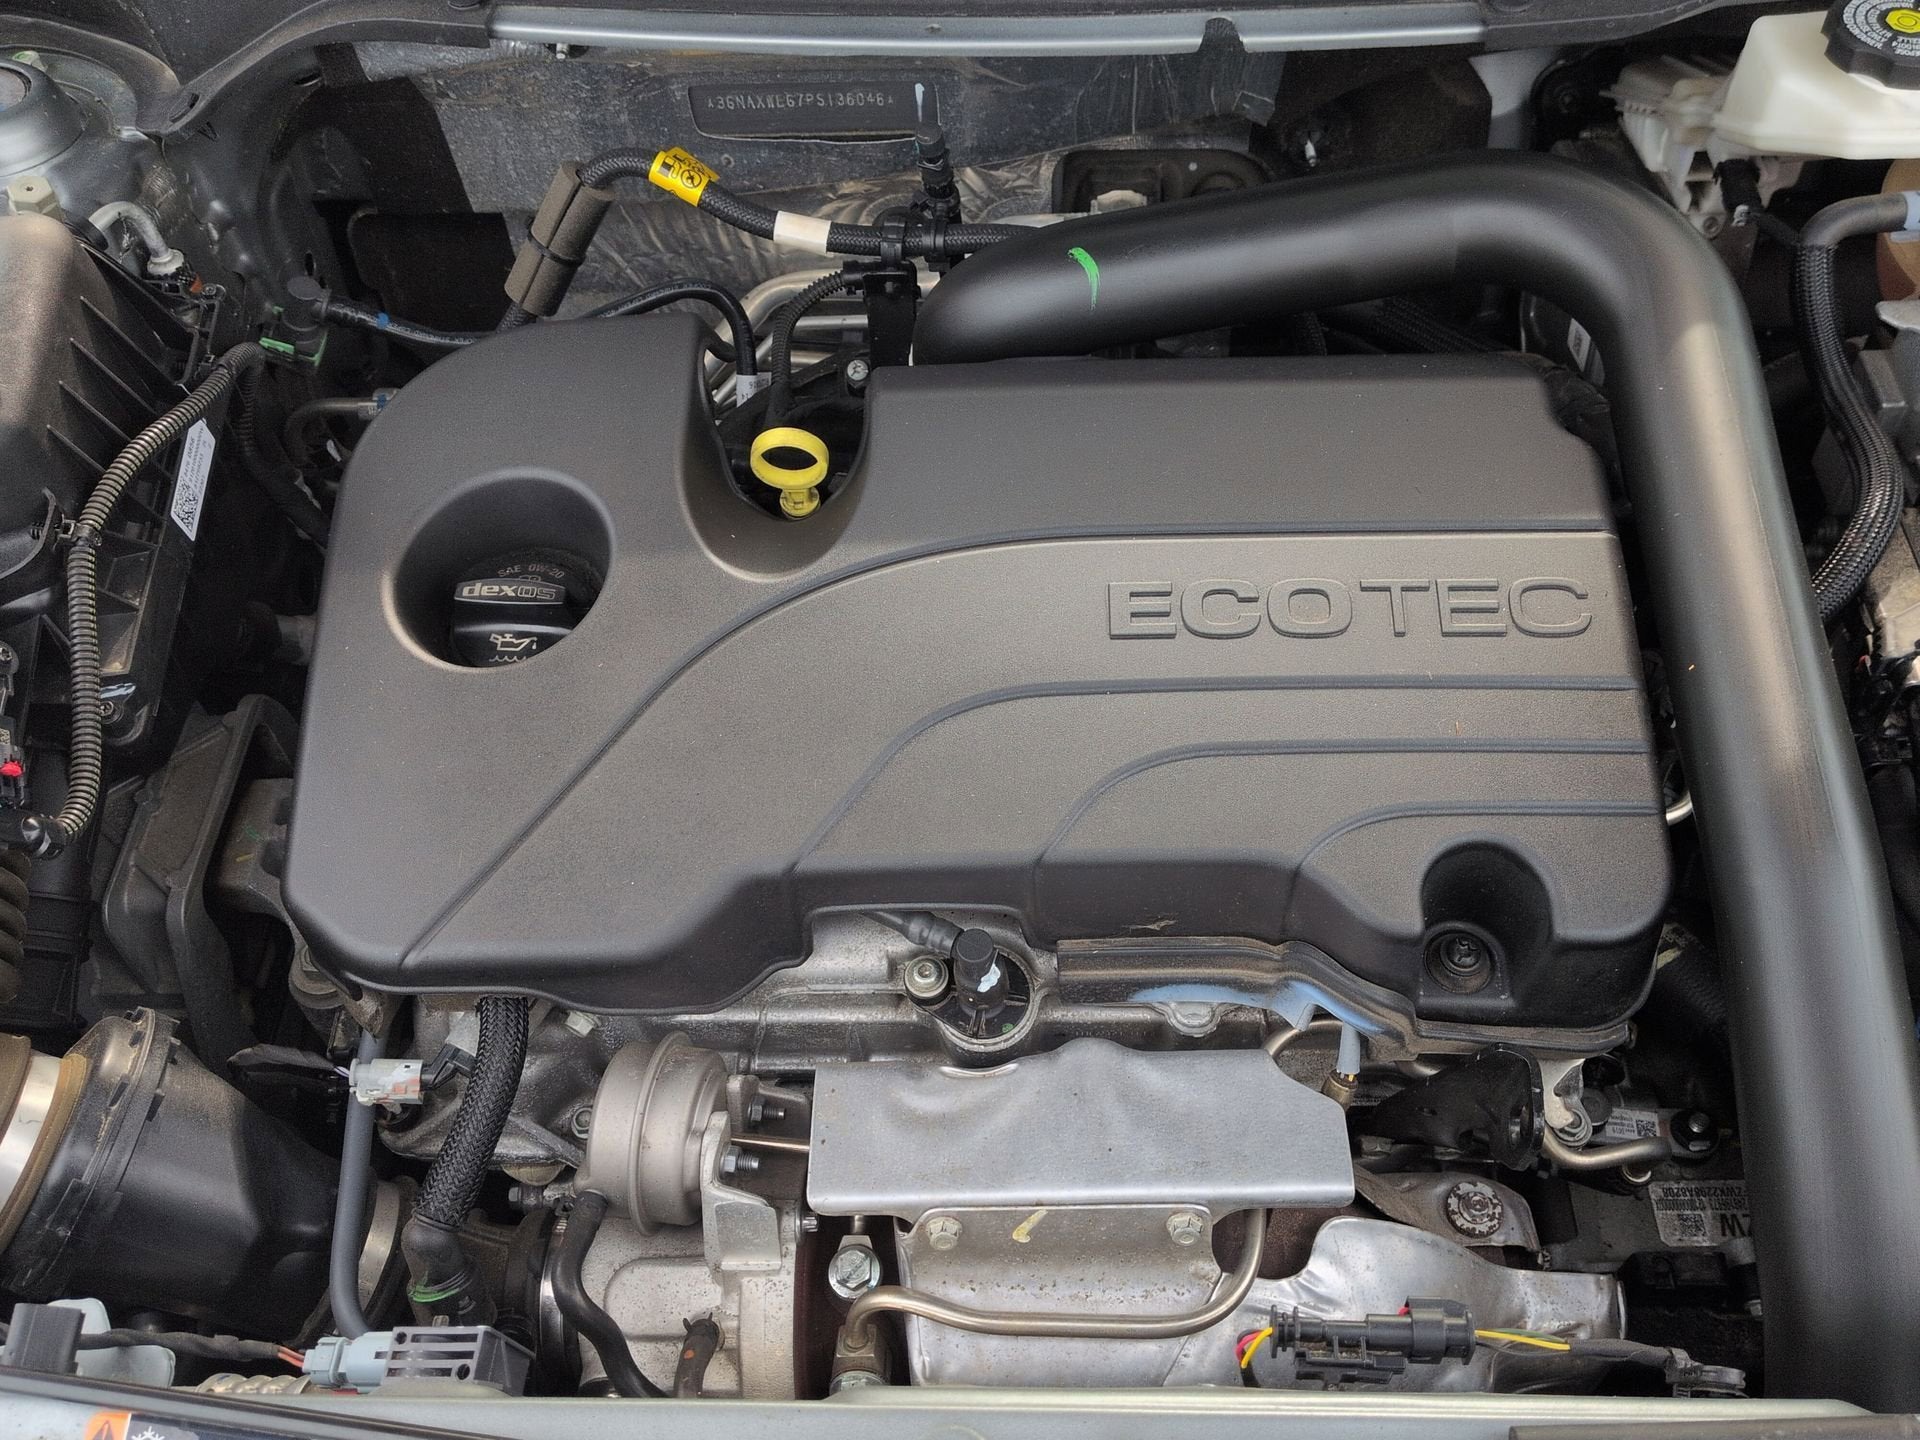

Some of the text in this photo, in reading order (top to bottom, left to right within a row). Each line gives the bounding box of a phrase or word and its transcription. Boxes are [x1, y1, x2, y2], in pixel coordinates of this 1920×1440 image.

[497, 564, 521, 577] SAE
[462, 582, 556, 599] dexos
[1107, 577, 1593, 639] ECOTEC
